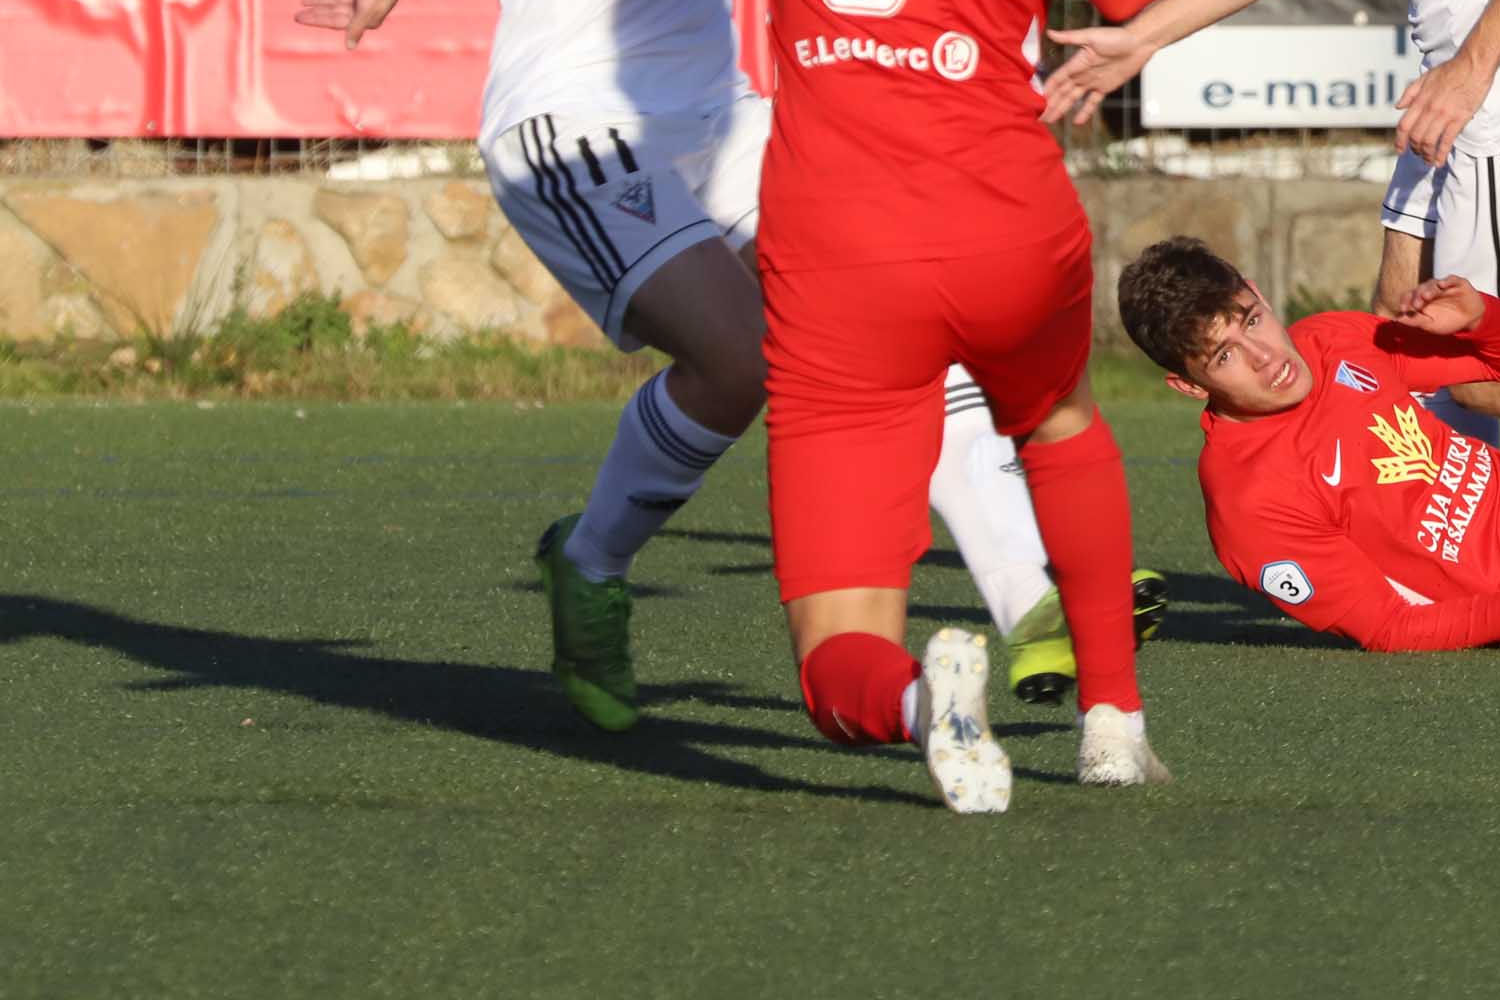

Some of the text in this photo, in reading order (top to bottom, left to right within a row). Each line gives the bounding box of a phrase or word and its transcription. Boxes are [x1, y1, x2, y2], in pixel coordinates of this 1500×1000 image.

[1417, 430, 1472, 553] CAJA RURA
[1441, 538, 1460, 564] DE
